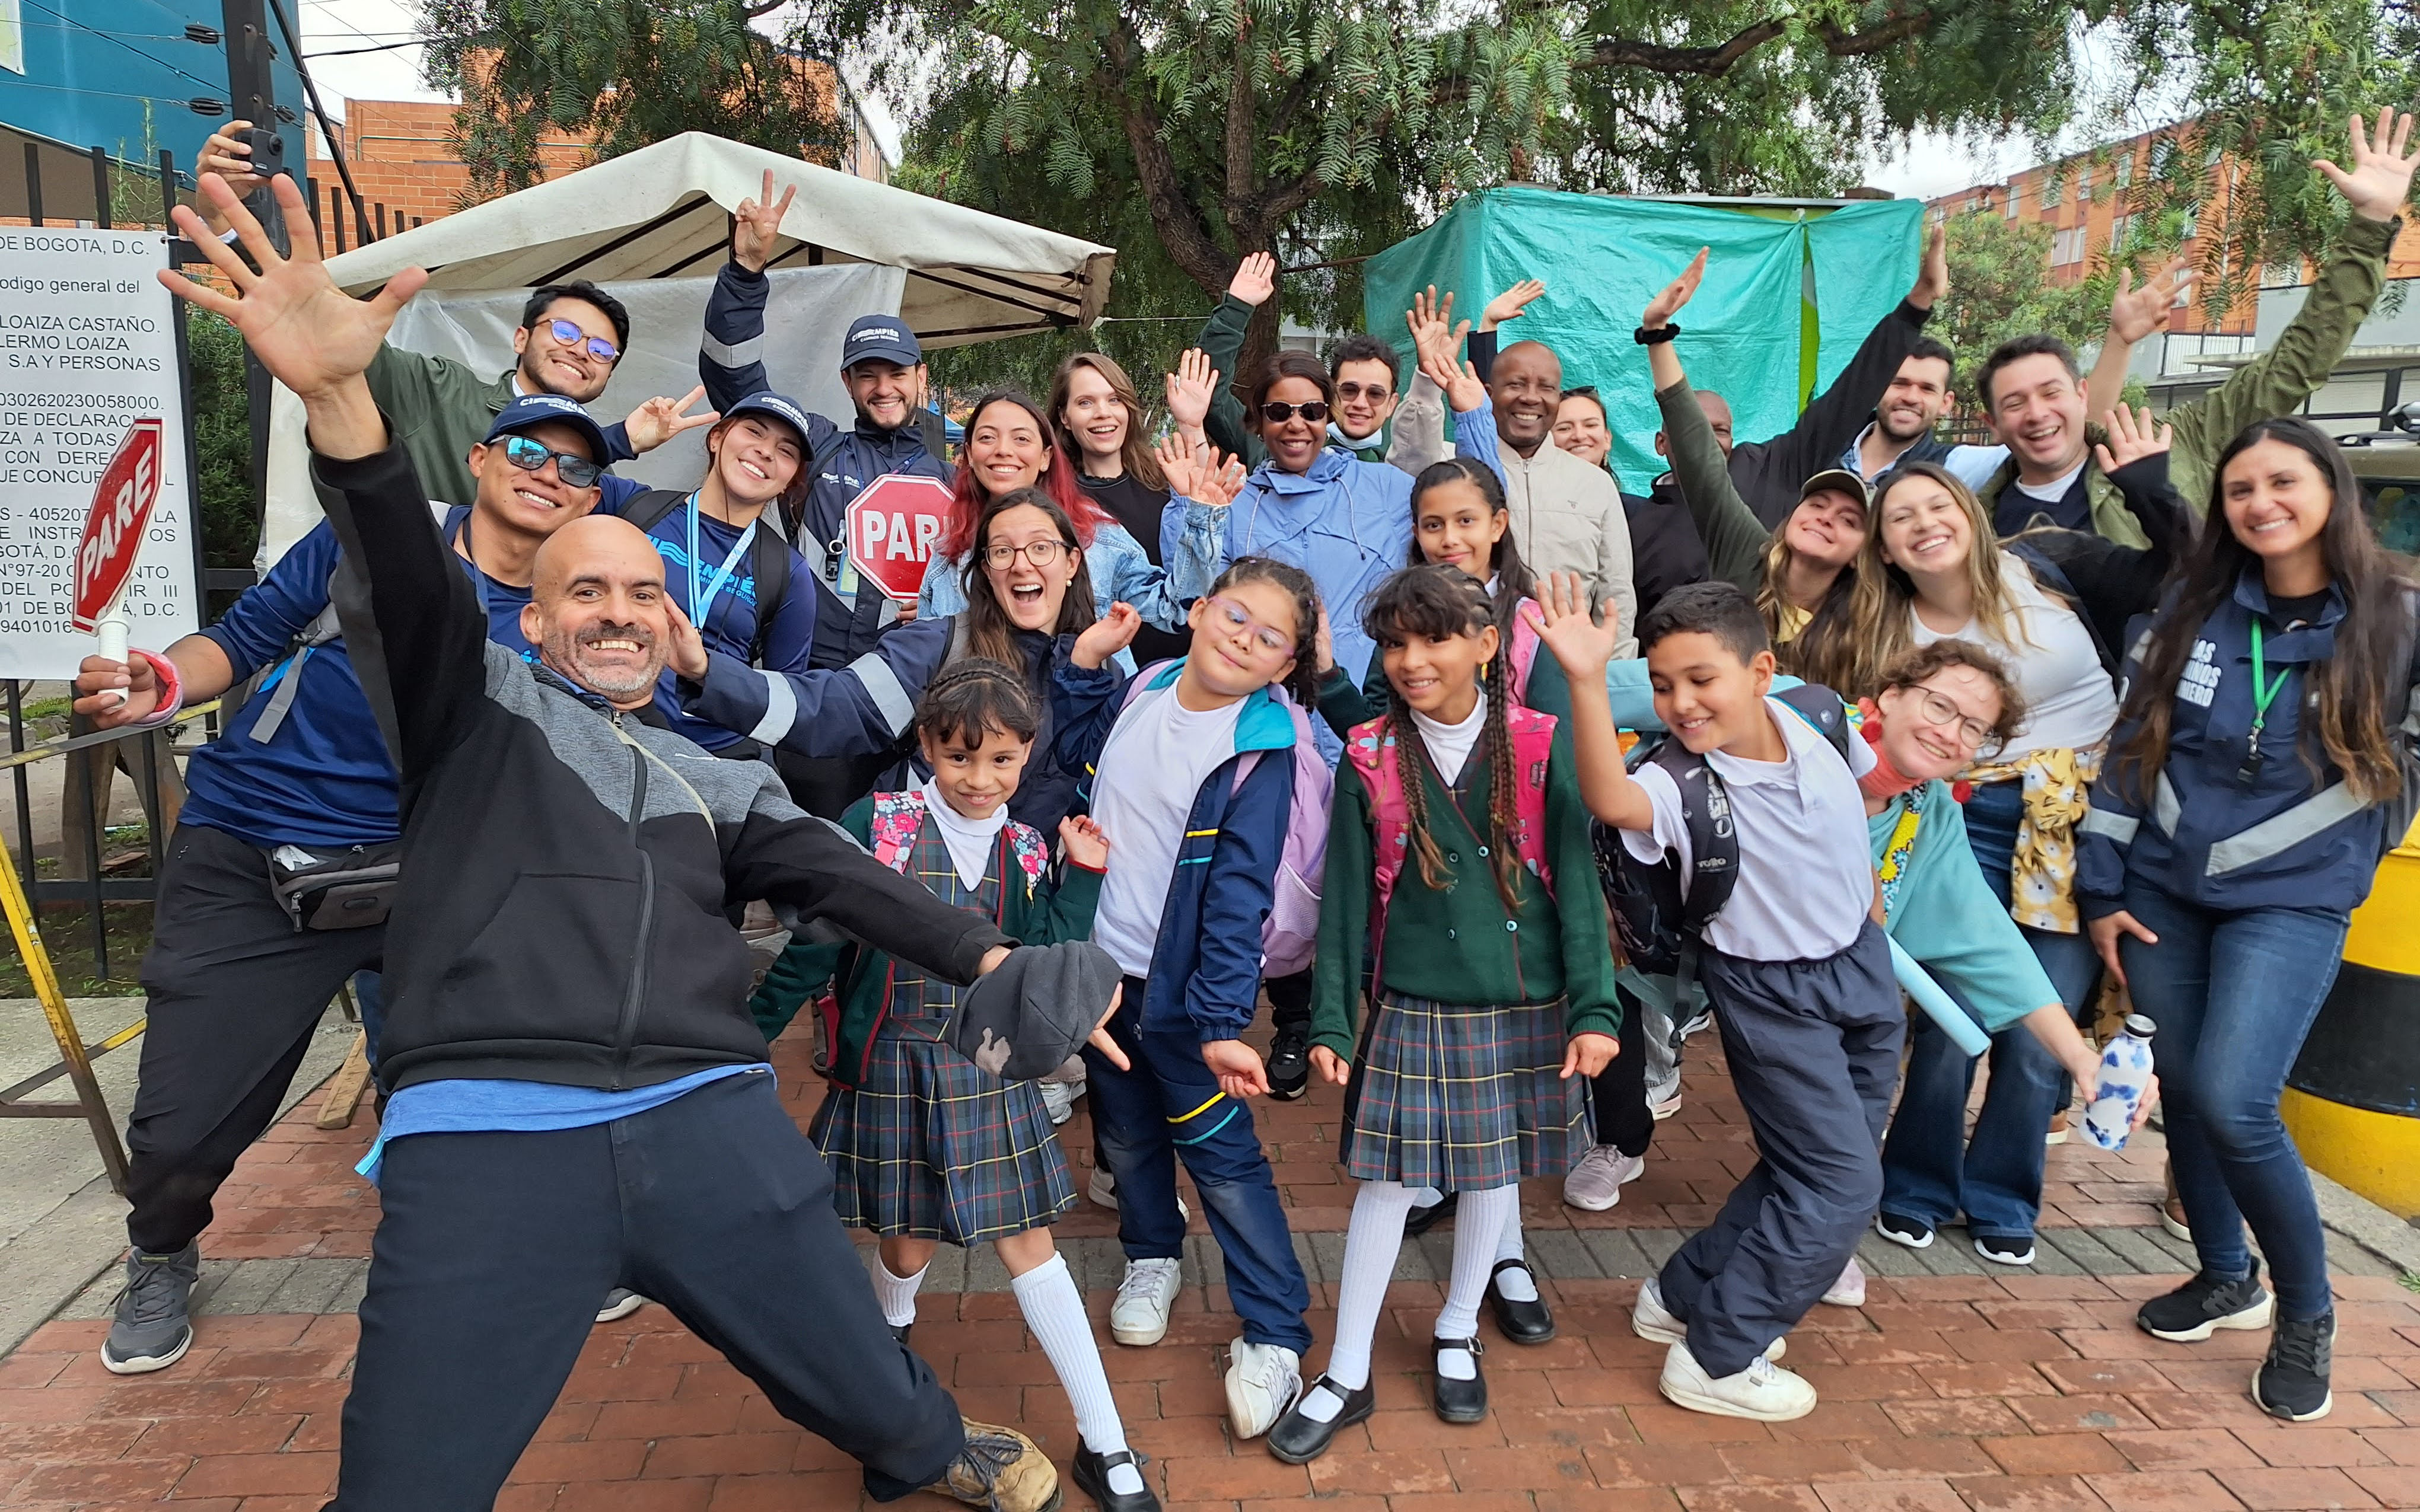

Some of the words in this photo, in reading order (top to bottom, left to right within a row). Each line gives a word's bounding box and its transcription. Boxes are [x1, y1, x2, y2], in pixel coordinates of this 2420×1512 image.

[24, 237, 106, 255] BOGOTA,
[113, 240, 149, 255] D.C.
[50, 279, 110, 294] general
[116, 279, 139, 293] del
[0, 315, 64, 330] LOAIZA
[69, 315, 161, 333] CASTAÑO.
[66, 336, 129, 351] LOAIZA
[59, 356, 161, 372] PERSONAS
[5, 412, 28, 425] DE
[0, 432, 22, 445] ZA
[34, 432, 44, 445] A
[52, 432, 117, 446] TODAS
[5, 451, 40, 464] CON
[81, 443, 153, 603] PARE
[154, 511, 177, 523] LA
[2, 582, 36, 595] DEL
[164, 585, 177, 598] III
[24, 601, 49, 614] DE
[144, 602, 180, 617] D.C.
